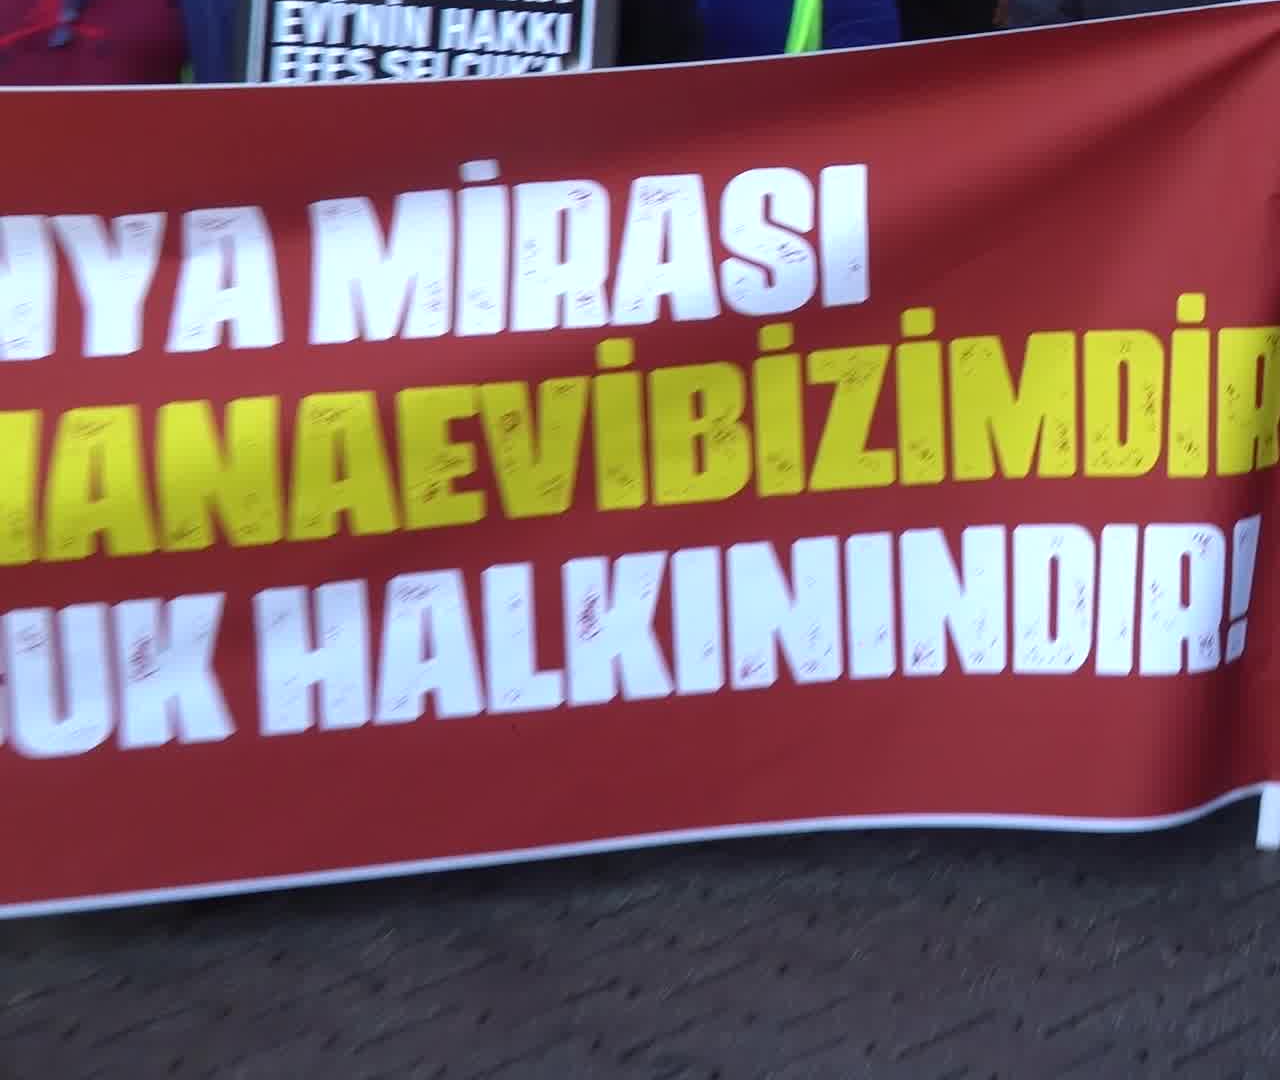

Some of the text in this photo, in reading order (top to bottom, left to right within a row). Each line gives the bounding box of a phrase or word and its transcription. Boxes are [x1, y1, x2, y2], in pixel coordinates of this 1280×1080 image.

[271, 45, 374, 83] EFES
[439, 8, 573, 54] HAKKI
[308, 158, 870, 345] MİRASI
[0, 514, 1262, 759] UK HALKININDIR!
